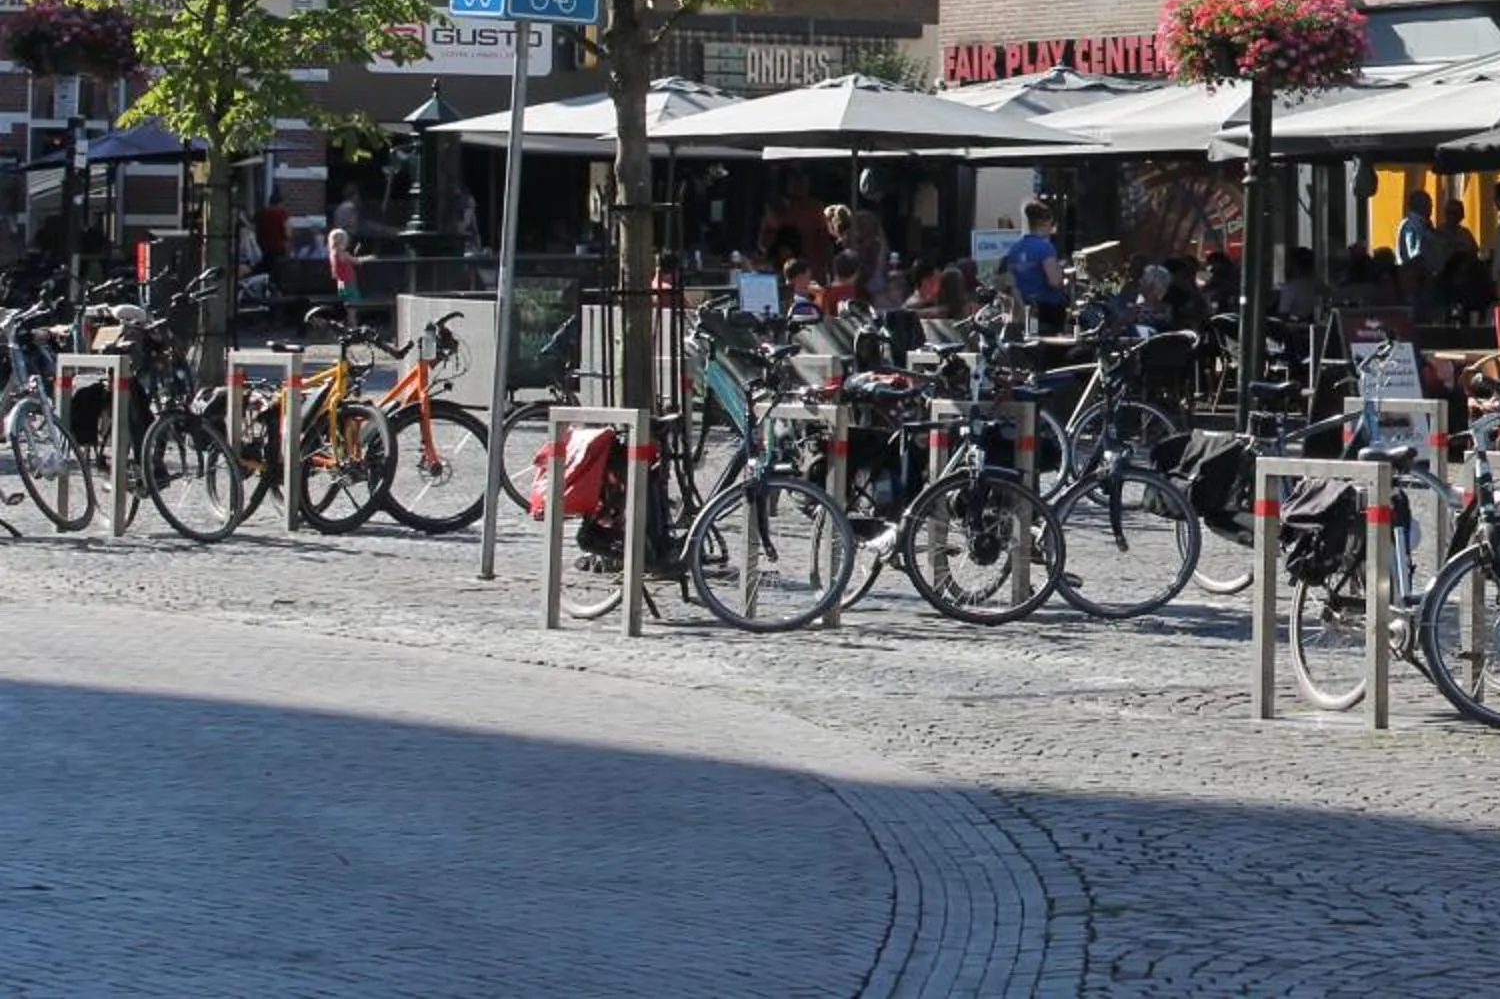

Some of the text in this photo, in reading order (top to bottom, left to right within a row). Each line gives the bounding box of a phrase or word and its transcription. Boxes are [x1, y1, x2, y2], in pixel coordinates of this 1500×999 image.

[432, 28, 543, 47] GUSTO
[747, 47, 832, 85] ANDERS
[944, 44, 998, 84] FAIR
[1004, 40, 1067, 81] PLAY
